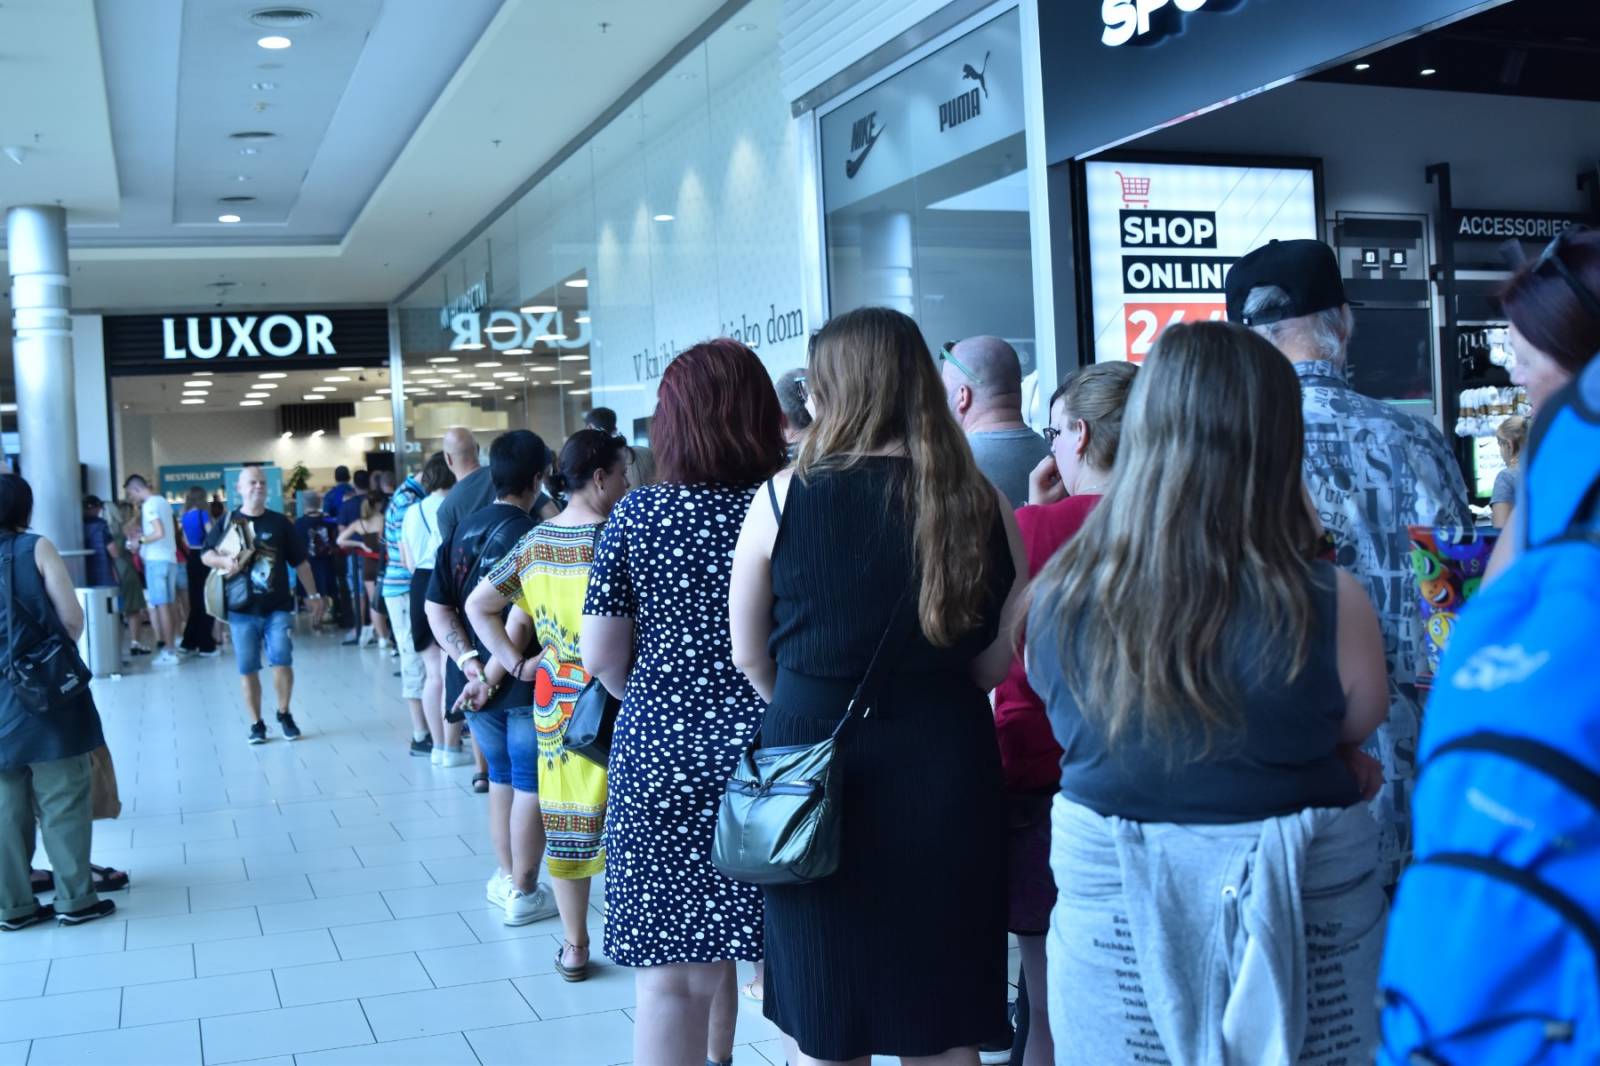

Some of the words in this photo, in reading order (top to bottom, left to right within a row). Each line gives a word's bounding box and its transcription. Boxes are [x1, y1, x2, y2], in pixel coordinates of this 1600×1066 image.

[939, 87, 981, 132] PUMA
[851, 110, 877, 152] NIKE
[1123, 216, 1214, 245] SHOP
[162, 314, 337, 359] LUXOR
[165, 472, 222, 481] BESTSELLERY
